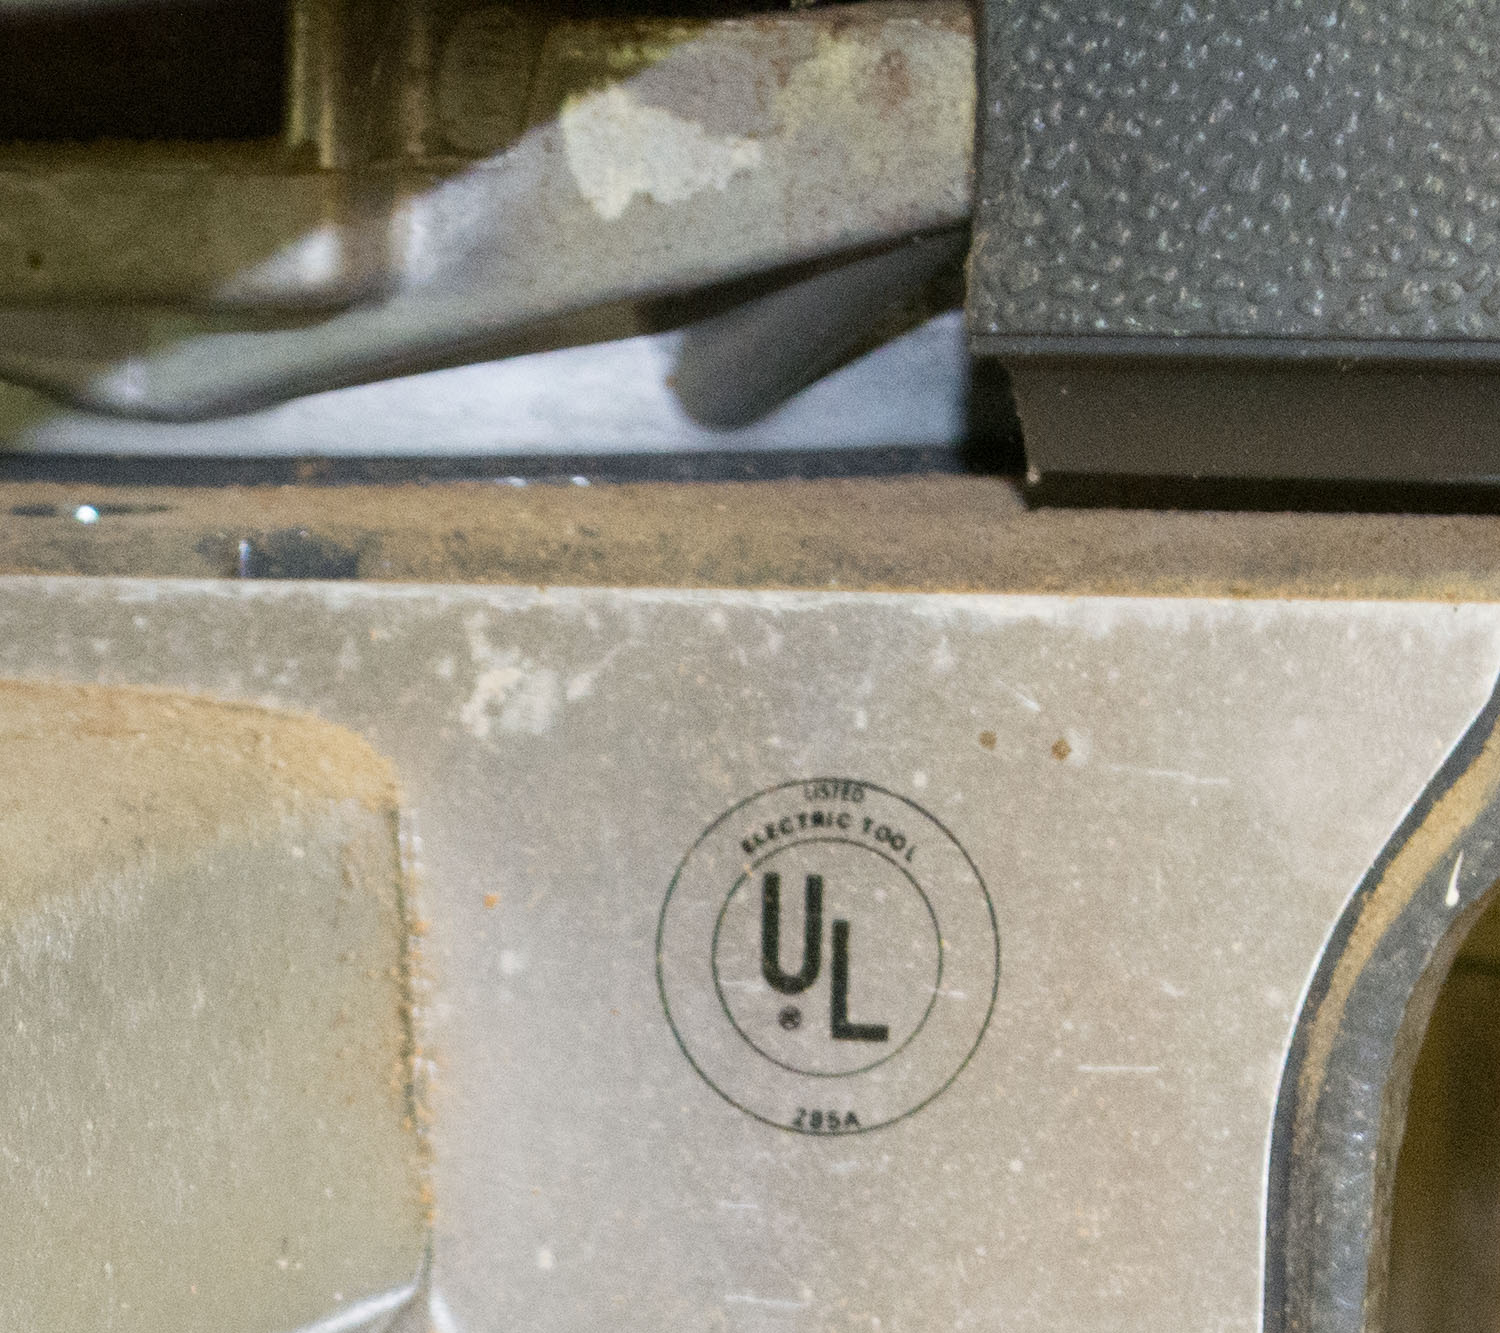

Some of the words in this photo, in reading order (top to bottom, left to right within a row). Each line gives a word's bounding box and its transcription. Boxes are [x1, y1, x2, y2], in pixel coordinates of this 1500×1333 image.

[740, 809, 852, 856] ELECTRIC
[862, 815, 916, 863] TOOL
[760, 871, 890, 1043] UL
